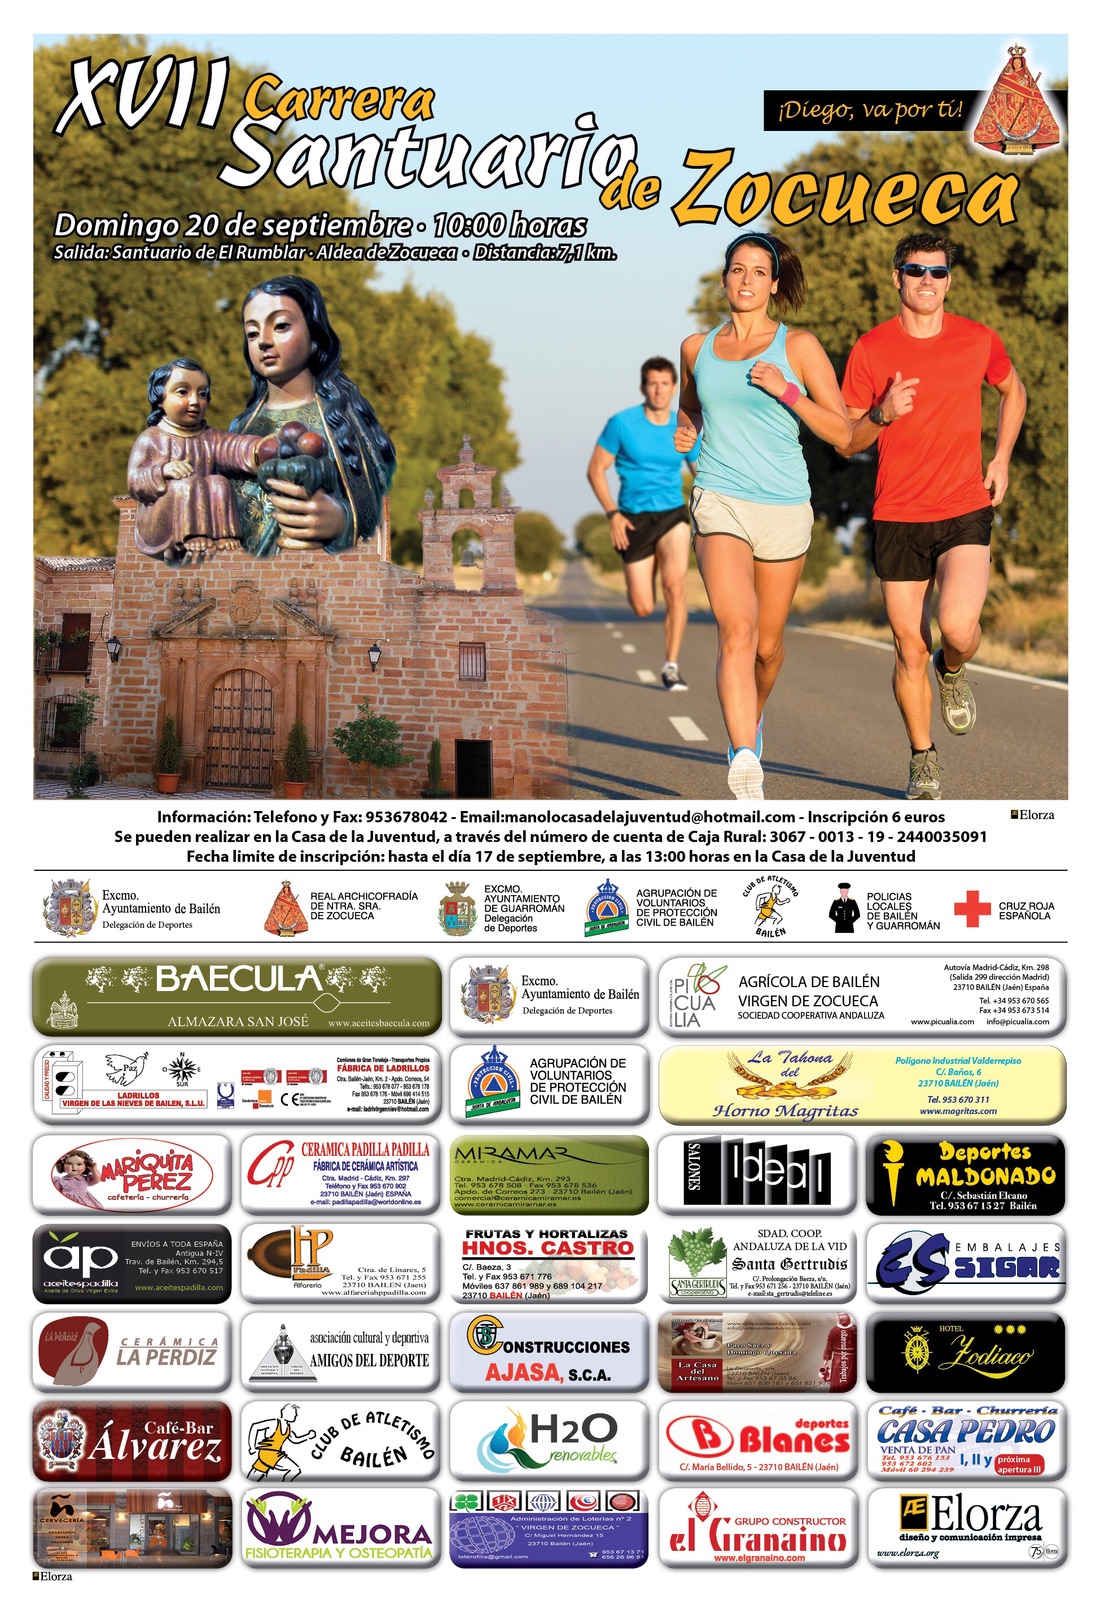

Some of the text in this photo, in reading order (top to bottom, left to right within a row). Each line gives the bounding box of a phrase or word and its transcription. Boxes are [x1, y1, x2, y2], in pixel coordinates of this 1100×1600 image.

[52, 53, 231, 136] XVII
[244, 72, 436, 122] Carrera
[863, 104, 894, 119] va
[895, 104, 934, 126] por
[218, 111, 640, 190] Santuario
[600, 147, 1021, 228] de Zocueca
[52, 211, 588, 241] Domingo 20 de septiembre 10:00 horas
[52, 243, 111, 262] Salida:
[111, 243, 193, 262] Santuario
[194, 243, 217, 262] de
[217, 243, 235, 262] El
[235, 243, 307, 262] Rumblar
[315, 243, 364, 262] Aldea
[364, 243, 388, 262] de
[387, 243, 458, 262] Zocueca
[584, 243, 618, 262] km.
[157, 809, 946, 827] Información: Telefono y Fax: 953678042 Email:manolocasadelajuventud@hotmail.com Inscripción 6 euros
[1019, 809, 1056, 821] Elorza
[114, 829, 987, 846] Se pueden realizar en la Casa de la Juventud, a través del número de cuenta de Caja Rural: 3067 0013 19 2440035091
[102, 889, 140, 901] Excmo.
[310, 890, 419, 901] REAL ARCHICOFRADÍA
[866, 892, 913, 902] POLICIAS
[102, 902, 221, 916] Ayuntamiento de Bailén
[310, 901, 382, 911] DE NTRA. SRA.
[866, 901, 913, 912] LOCALES
[998, 901, 1056, 911] CRUZ ROJA
[310, 911, 375, 921] DE ZOCUECA
[866, 909, 919, 921] DE BAILÉN
[999, 909, 1052, 921] ESPAÑOLA
[102, 920, 193, 931] Delegación de Deportes
[866, 919, 941, 931] Y GUARROMÁN
[157, 965, 323, 991] BAECULA
[738, 973, 880, 988] AGRÍCOLA DE BAILÉN
[737, 994, 879, 1008] VIRGEN DE ZOCUECA
[167, 1013, 309, 1027] ALMAZARA SAN JOSÉ
[328, 1019, 430, 1027] www.aceitesbaecula.com
[910, 1017, 975, 1027] www.picualia.com
[746, 1050, 834, 1065] La Tahona
[336, 1061, 431, 1073] FÁBRICA DE LADRILLOS
[780, 1066, 801, 1078] del
[712, 1101, 858, 1121] Horno Magritas
[919, 1106, 998, 1117] www.magritas.com
[302, 1142, 430, 1157] CERAMICA PADILLA PADILLA
[455, 1146, 576, 1161] MIRAMAR
[939, 1140, 1032, 1165] Deportes
[686, 1142, 702, 1192] SALONES
[123, 1172, 193, 1193] PEREZ
[917, 1167, 1055, 1186] MALDONADO
[465, 1229, 629, 1239] FRUTAS Y HORTALIZAS
[463, 1241, 634, 1255] HNOS. CASTRO
[955, 1242, 1061, 1253] EMBALAJES
[732, 1256, 849, 1271] Santa Gertrudis
[955, 1256, 1060, 1278] SIGAR
[135, 1284, 224, 1292] www.aceitespadilla.com
[121, 1336, 218, 1347] CERÁMICA
[117, 1349, 217, 1365] LA PERDIZ
[309, 1353, 430, 1368] AMIGOS DEL DEPORTE
[486, 1363, 612, 1383] AJASA, S.C.A.
[144, 1421, 214, 1436] Café-Bar
[795, 1418, 849, 1432] deportes
[877, 1419, 1056, 1444] CASA PEDRO
[88, 1420, 222, 1463] Álvarez
[740, 1425, 850, 1453] Blanes
[549, 1444, 619, 1462] renovables
[932, 1493, 1043, 1531] Elorza
[734, 1517, 847, 1526] GRUPO CONSTRUCTOR
[313, 1525, 432, 1544] MEJORA
[669, 1517, 696, 1552] el
[899, 1532, 1043, 1543] diseño y comunicación impresa
[245, 1547, 433, 1559] FISIOTERAPIA Y OSTEOPATÍA
[713, 1554, 807, 1564] www.elgranaino.com
[876, 1547, 940, 1560] www.elorza.org
[40, 1571, 73, 1582] Elorza
